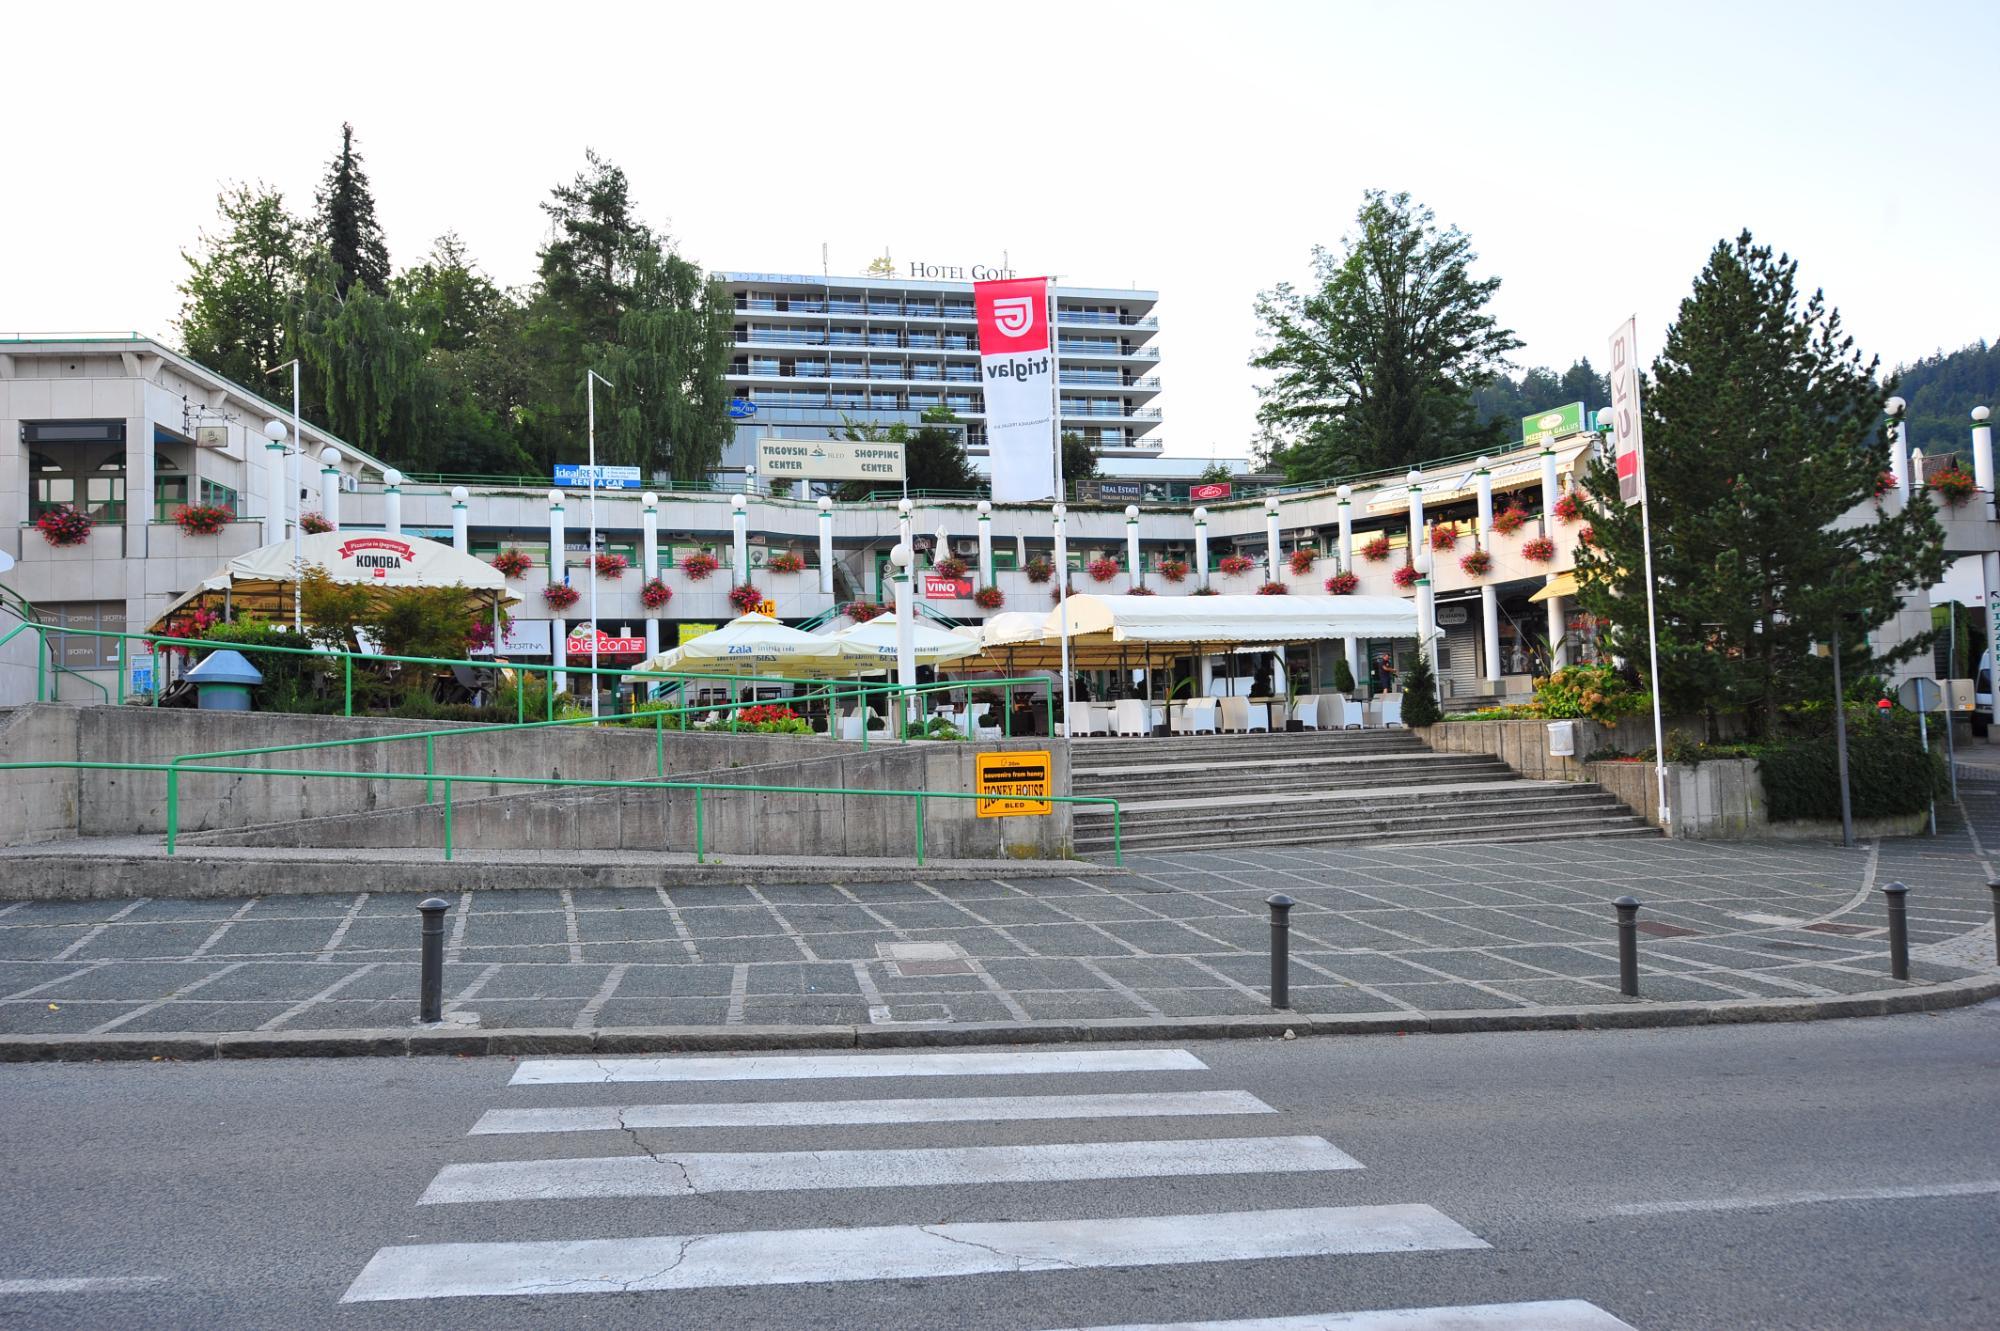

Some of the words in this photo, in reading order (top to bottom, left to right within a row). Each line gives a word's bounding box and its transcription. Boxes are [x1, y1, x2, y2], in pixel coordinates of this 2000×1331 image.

[911, 262, 967, 280] HOTEL
[972, 265, 1017, 282] GOLF
[1554, 422, 1579, 434] GALLUS
[763, 446, 808, 456] TRGOVSKI
[854, 449, 899, 459] SHOPPING
[769, 461, 802, 470] CENTER
[861, 463, 894, 473] CENTER
[570, 478, 591, 487] REN
[1101, 485, 1117, 493] REAL
[1118, 486, 1139, 494] ESTATE
[356, 554, 401, 569] KONOBA
[927, 583, 956, 592] VINO
[103, 614, 127, 622] SPORTIN
[728, 644, 753, 654] Zala
[984, 785, 1013, 809] HONEY
[1015, 784, 1044, 806] HOUSE
